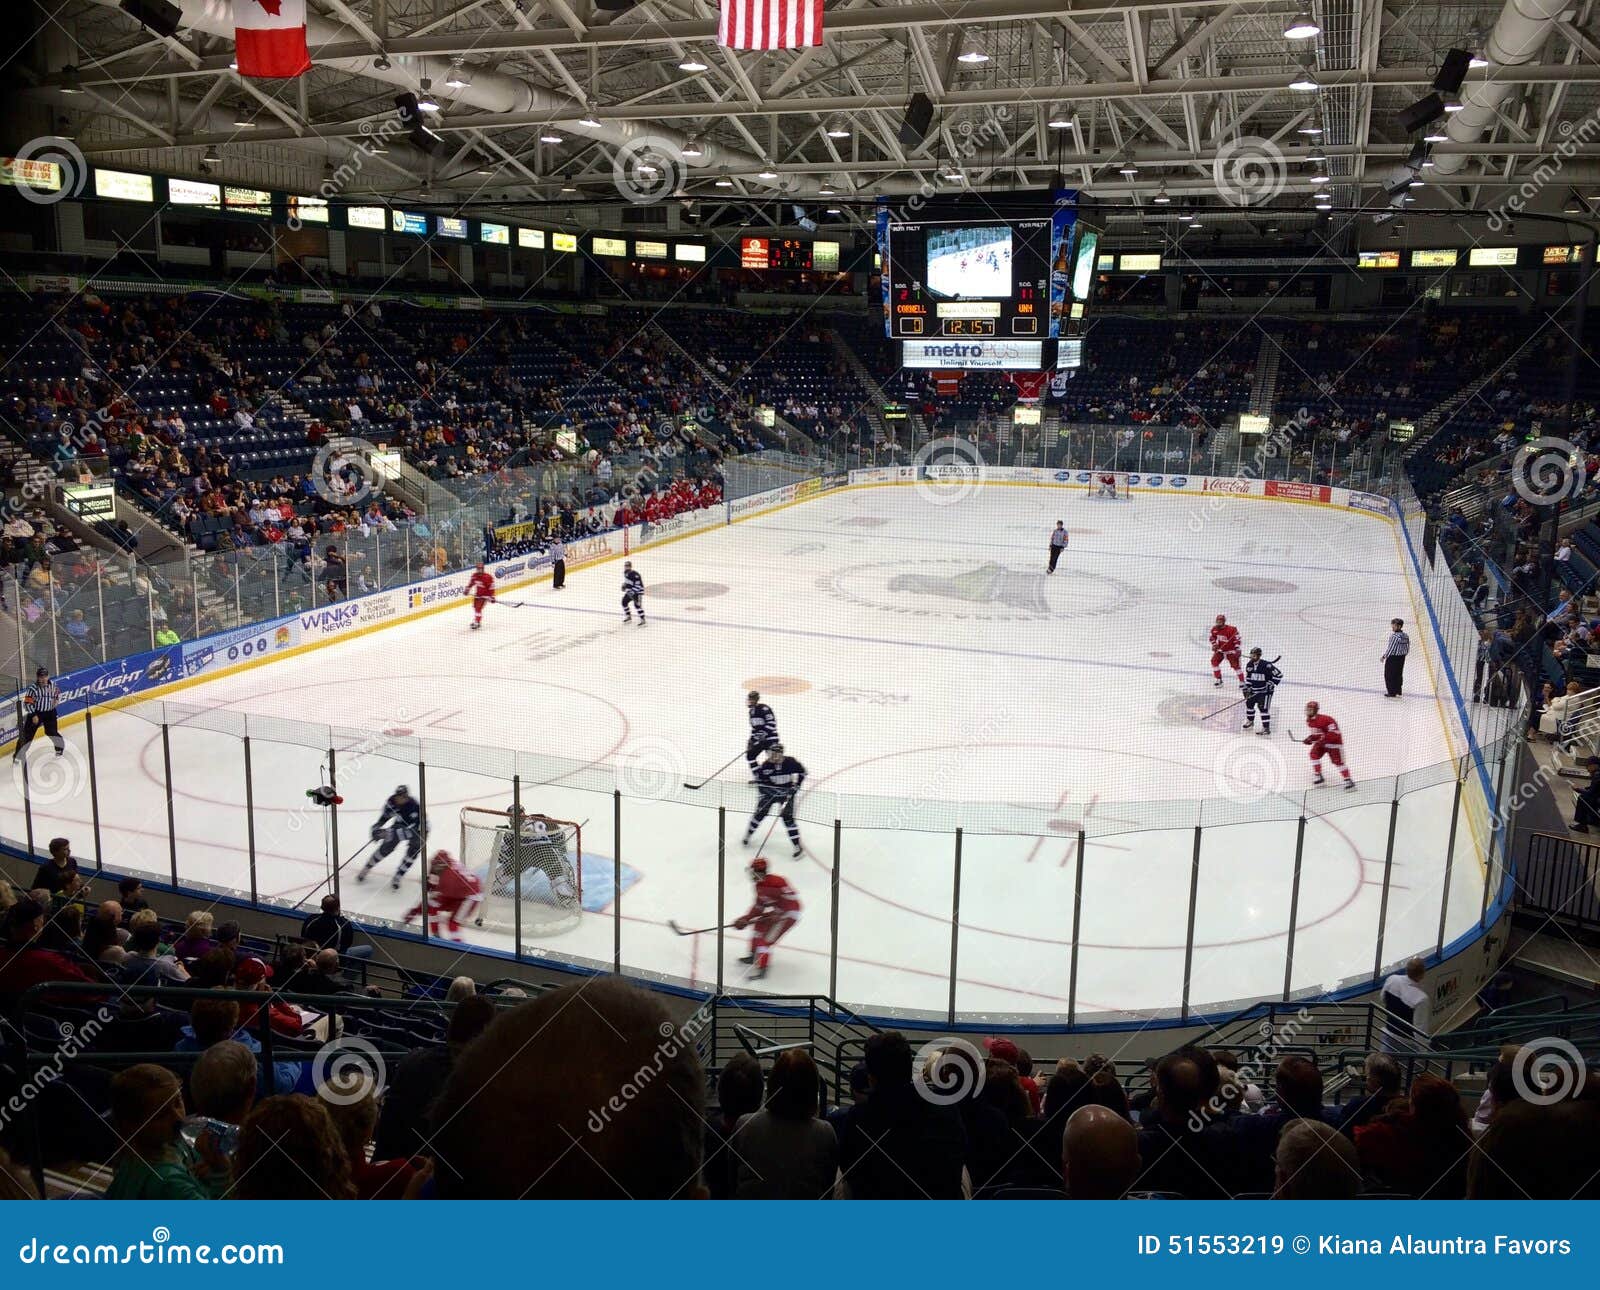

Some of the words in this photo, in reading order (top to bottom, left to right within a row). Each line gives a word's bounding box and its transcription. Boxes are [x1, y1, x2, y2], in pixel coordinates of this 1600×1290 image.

[897, 304, 927, 314] CORNELL
[437, 586, 465, 600] storage
[301, 605, 351, 630] WINK
[322, 619, 352, 633] NEWS
[59, 685, 90, 704] BUD
[98, 669, 144, 691] LIGHT
